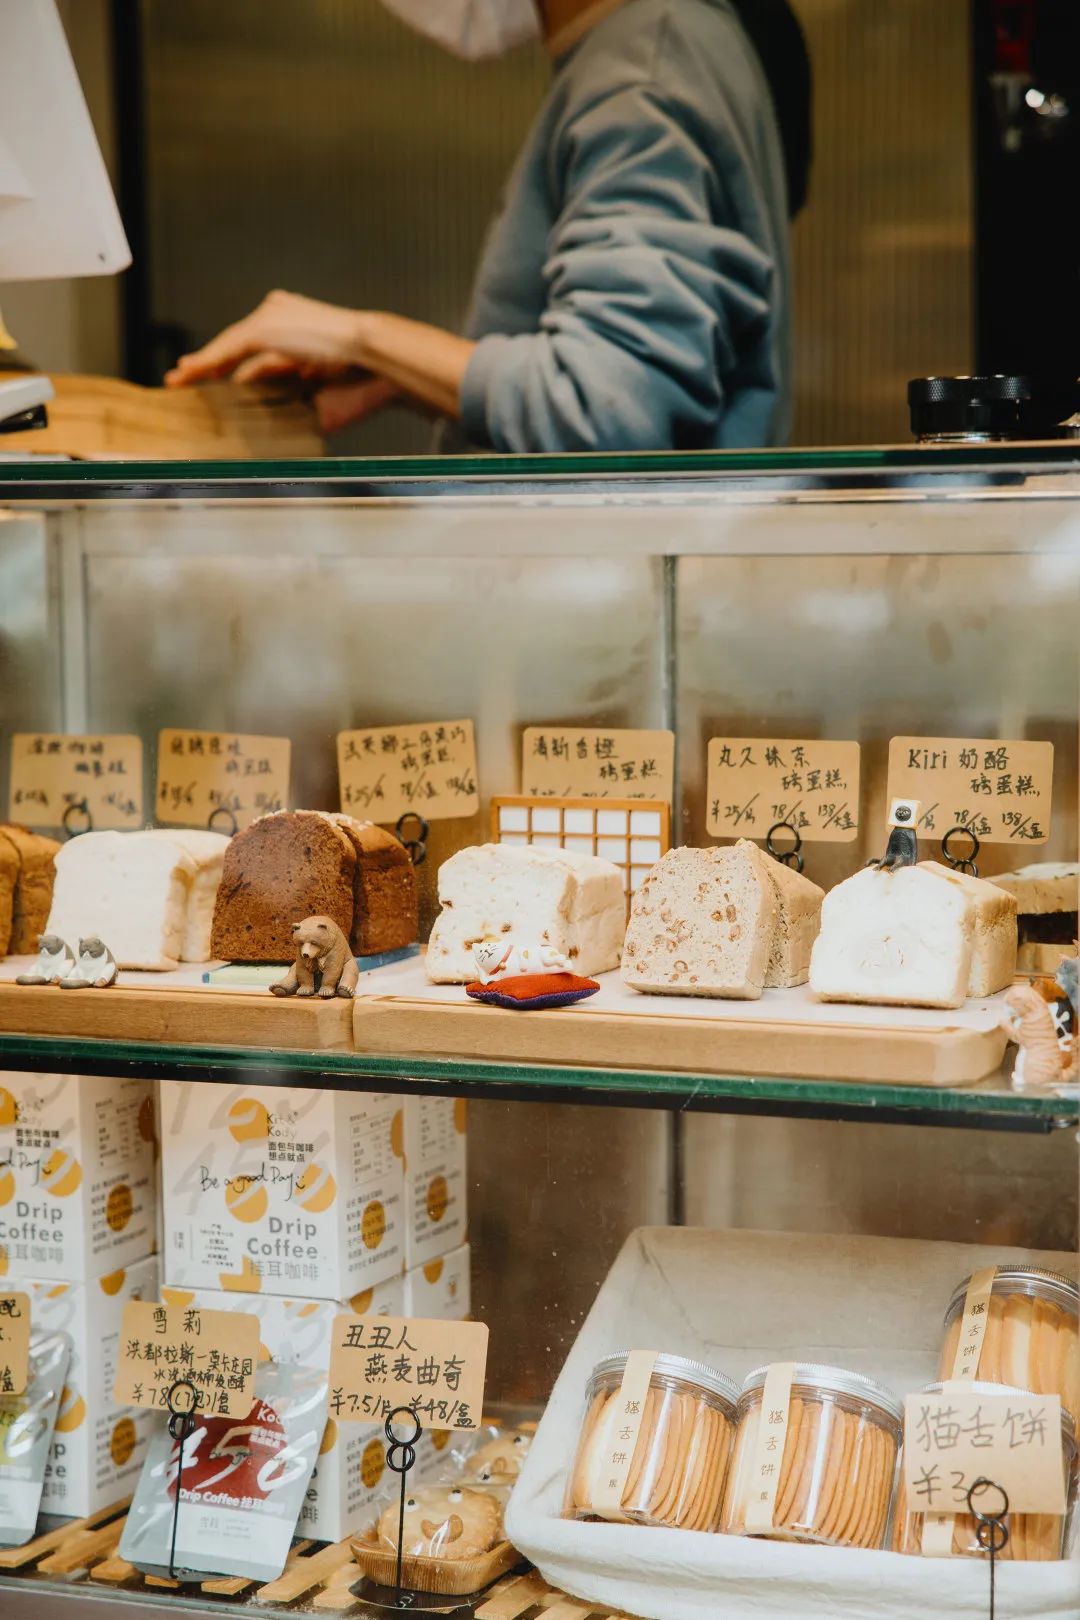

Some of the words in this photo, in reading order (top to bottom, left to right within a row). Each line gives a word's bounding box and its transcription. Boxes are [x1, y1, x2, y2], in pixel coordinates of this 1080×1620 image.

[907, 749, 947, 769] Kiri
[959, 747, 1010, 770] 奶酪
[268, 1141, 314, 1152] 面包与咖啡
[200, 1166, 219, 1192] Be
[224, 1178, 233, 1186] a
[232, 1162, 268, 1194] good
[270, 1166, 294, 1201] Day
[16, 1201, 63, 1224] Drip
[269, 1216, 317, 1240] Drip
[247, 1237, 318, 1259] Coffee
[153, 1307, 201, 1335] 雪莉
[342, 1324, 418, 1351] 丑丑人
[365, 1353, 466, 1391] 燕麦曲奇
[612, 1401, 640, 1465] 猫舌饼
[916, 1405, 1047, 1452] 猫舌饼
[761, 1410, 784, 1476] 猫舌饼
[178, 1488, 201, 1503] Drip
[202, 1491, 240, 1507] Coffee
